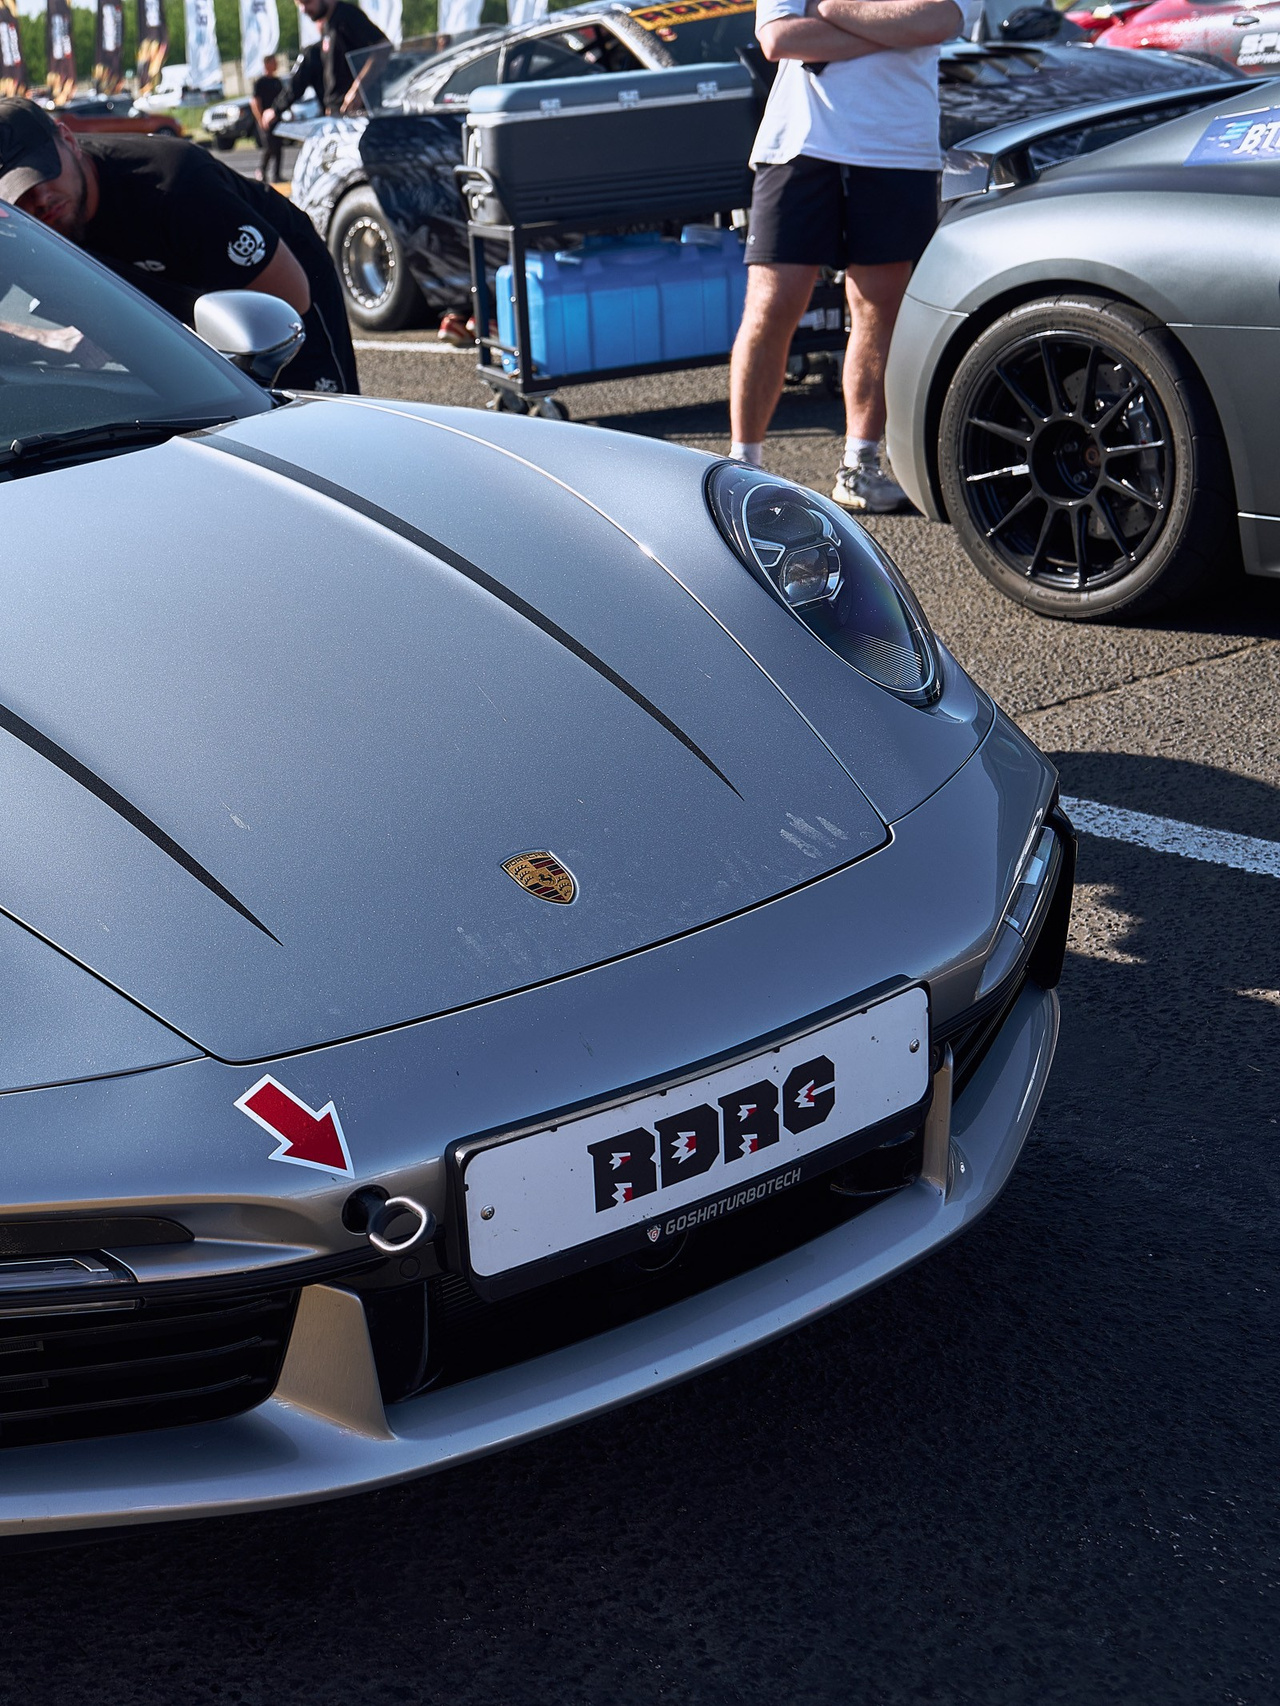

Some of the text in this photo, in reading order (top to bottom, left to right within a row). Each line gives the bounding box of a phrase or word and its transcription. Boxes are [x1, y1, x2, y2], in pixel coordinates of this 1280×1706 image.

[1240, 32, 1280, 54] SP
[586, 1053, 836, 1214] RDRC
[665, 1167, 802, 1236] GOSHATURBOTECH
